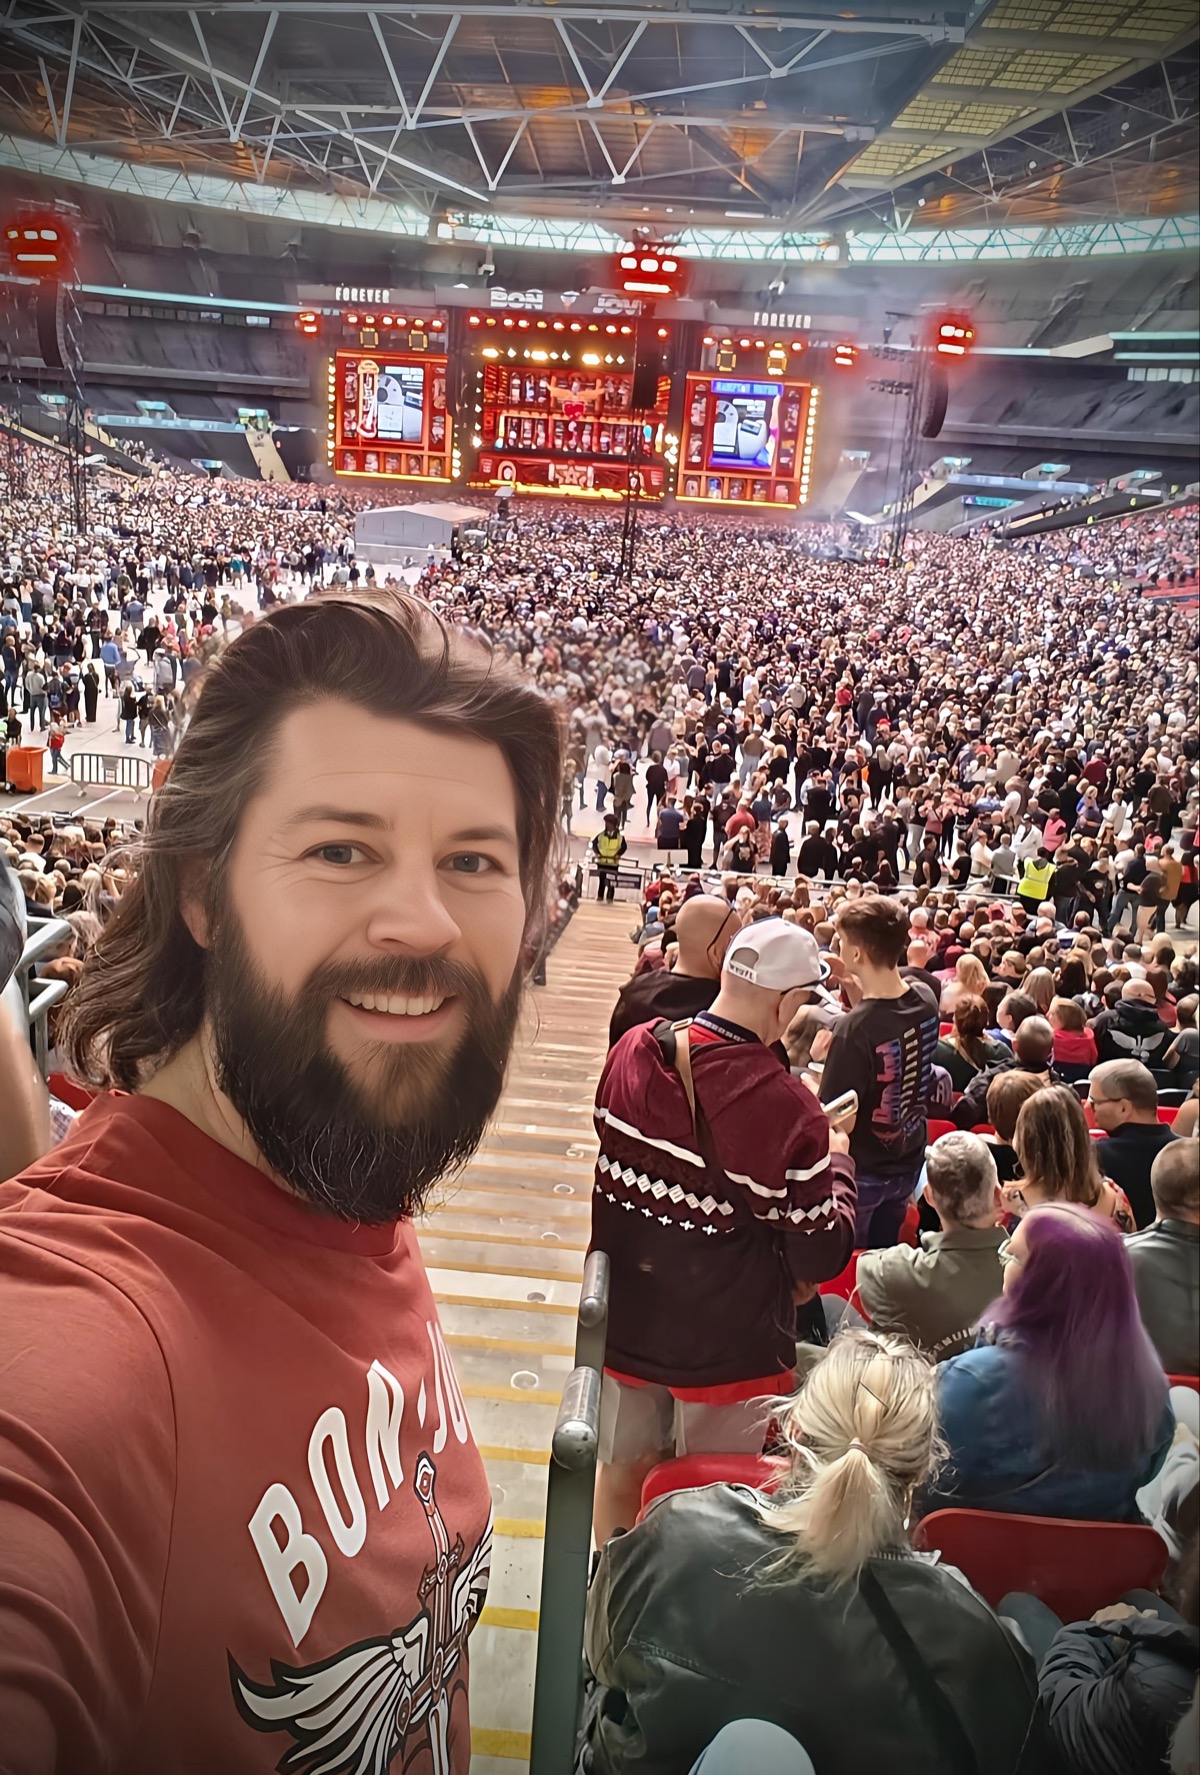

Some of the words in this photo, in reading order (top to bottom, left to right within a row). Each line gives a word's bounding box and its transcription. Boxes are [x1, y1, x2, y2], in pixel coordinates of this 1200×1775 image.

[335, 287, 390, 304] FOREVER
[490, 286, 543, 310] BON
[593, 294, 642, 316] JOVI
[753, 312, 812, 329] FOREVER
[248, 1358, 404, 1648] BON
